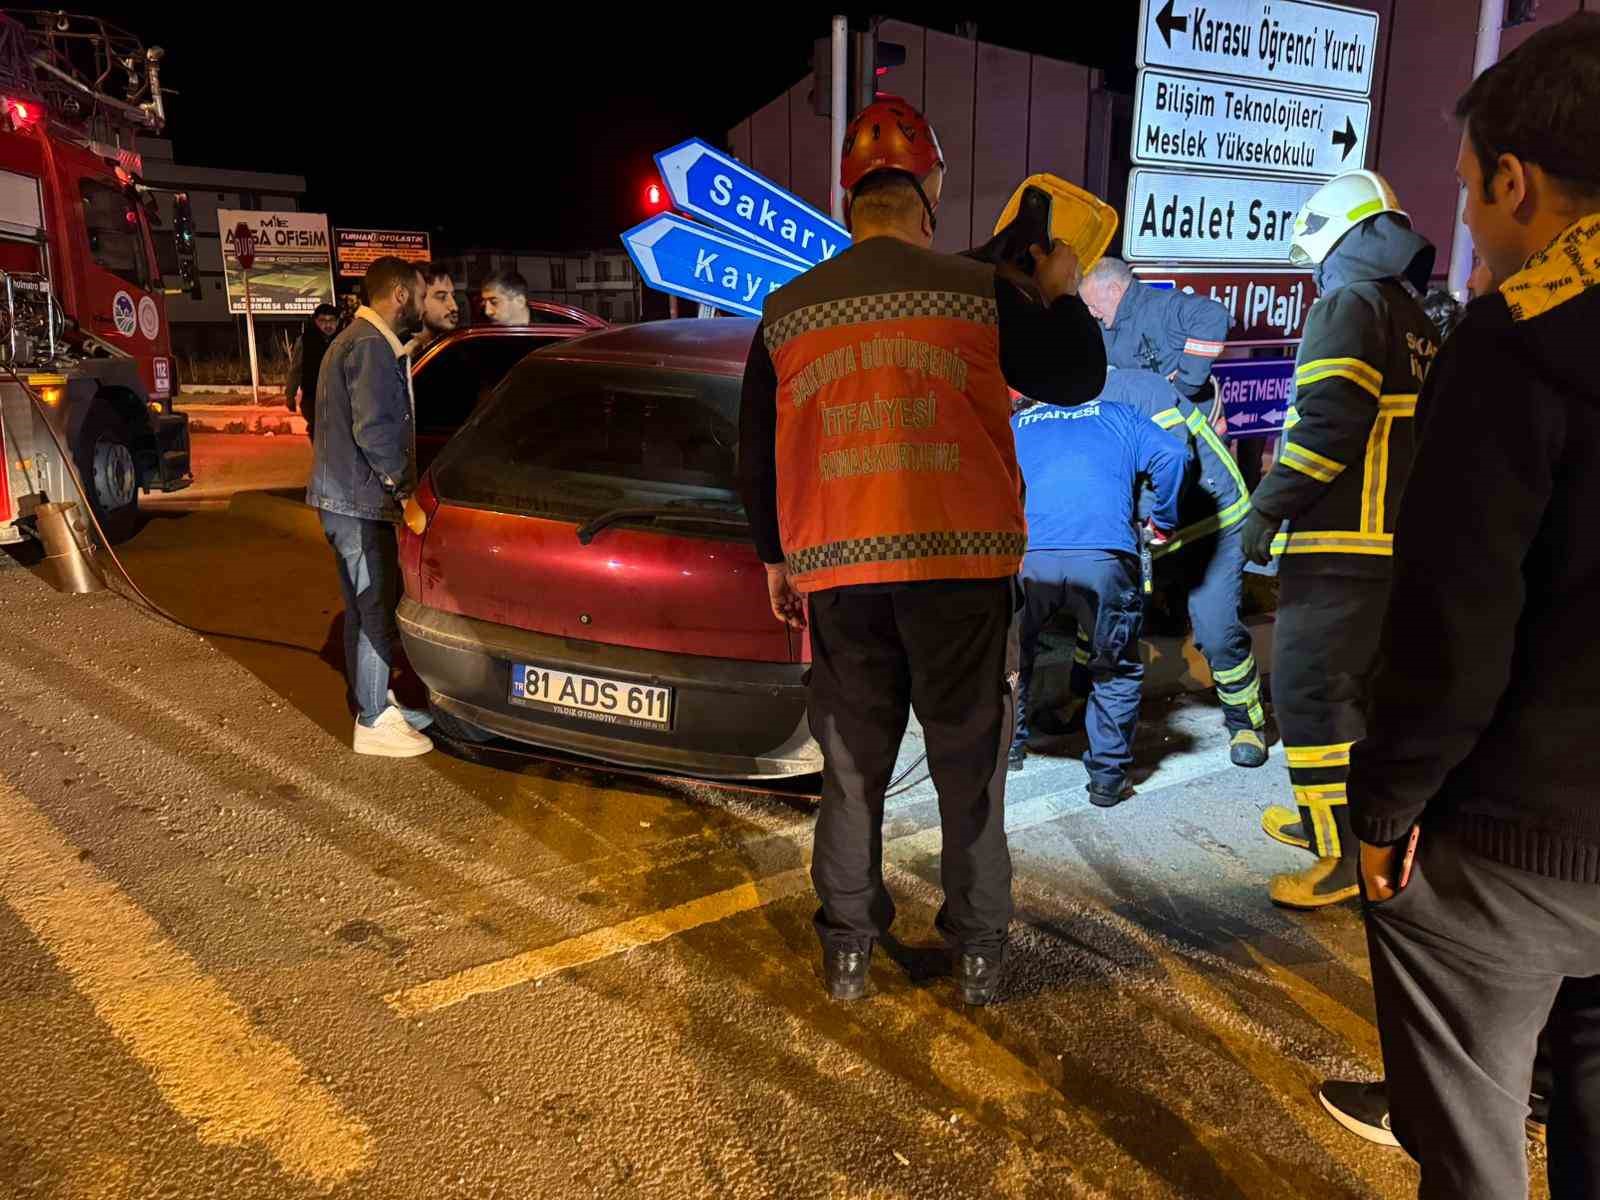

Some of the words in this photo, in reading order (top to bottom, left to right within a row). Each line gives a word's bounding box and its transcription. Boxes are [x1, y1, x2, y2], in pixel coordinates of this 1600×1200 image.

[1192, 8, 1250, 58] Karasu
[1259, 6, 1318, 71] Öğrenci
[1324, 30, 1366, 73] Yurdu
[1156, 82, 1215, 121] Bilişim
[1225, 92, 1323, 131] Teknolojileri
[1146, 125, 1207, 158] Meslek
[1217, 132, 1315, 167] Yüksekokulu
[275, 230, 326, 247] OFİSİM
[1139, 193, 1235, 240] Adalet
[1247, 199, 1299, 241] Sar
[234, 238, 255, 257] DUR
[1244, 281, 1303, 336] (Plaj)
[822, 390, 937, 437] İTFAİYESİ
[514, 682, 524, 692] TR
[526, 669, 550, 698] 81
[559, 676, 618, 710] ADS
[627, 687, 666, 719] 611
